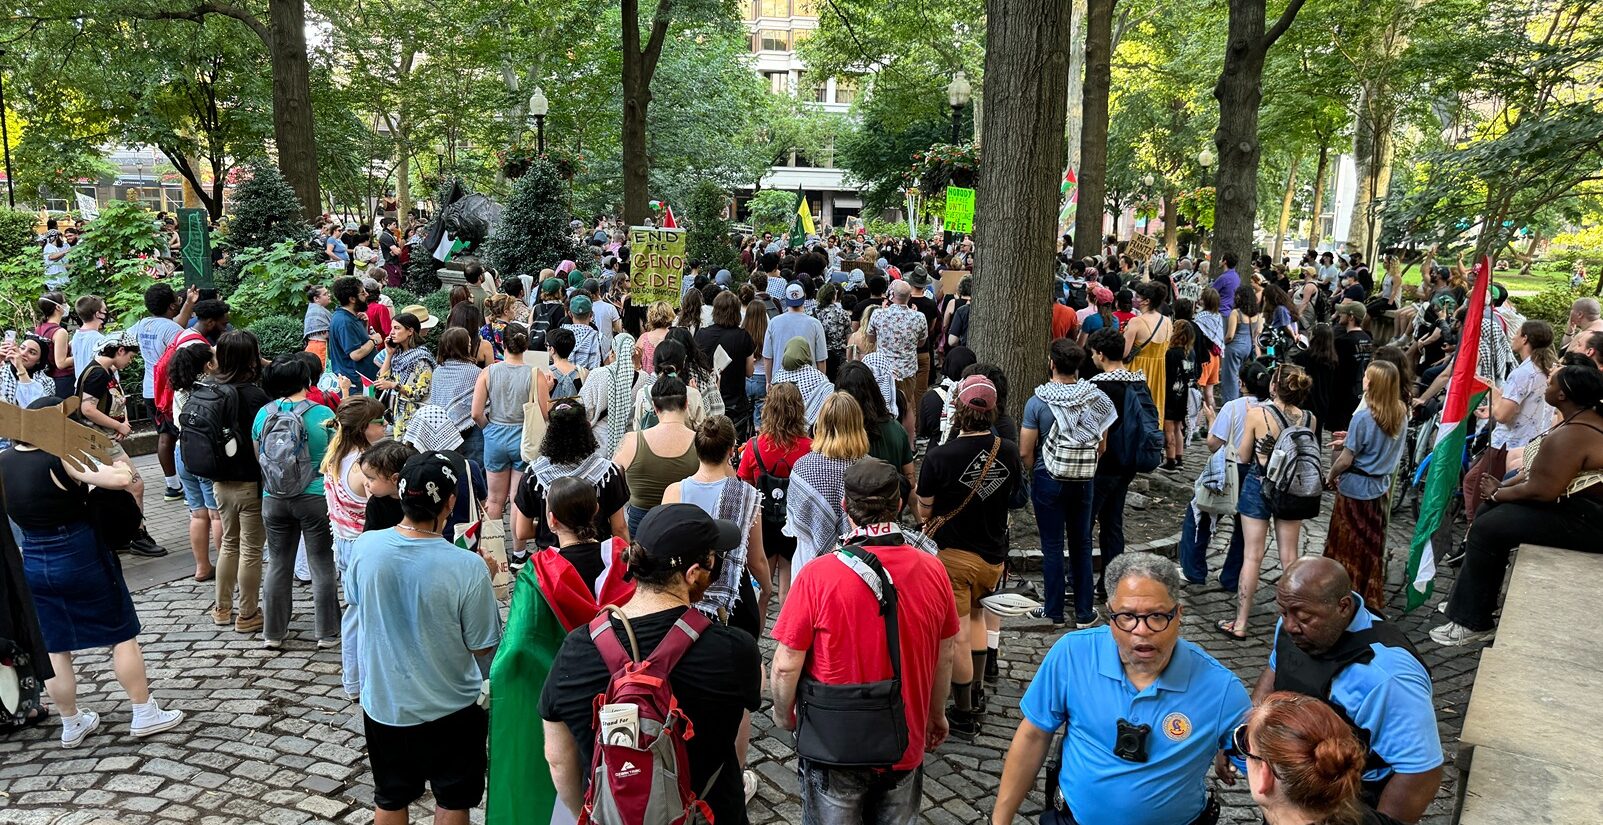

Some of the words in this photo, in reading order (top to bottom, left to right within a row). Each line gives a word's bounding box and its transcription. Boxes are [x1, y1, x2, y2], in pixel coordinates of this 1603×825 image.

[947, 188, 972, 198] NOBODY
[948, 203, 968, 212] UNTIL
[945, 221, 966, 231] FREE
[634, 231, 678, 243] END
[1137, 234, 1151, 245] READ
[647, 243, 668, 251] THE
[633, 252, 683, 270] GENO
[633, 271, 679, 291] CIDE
[497, 562, 508, 572] NE
